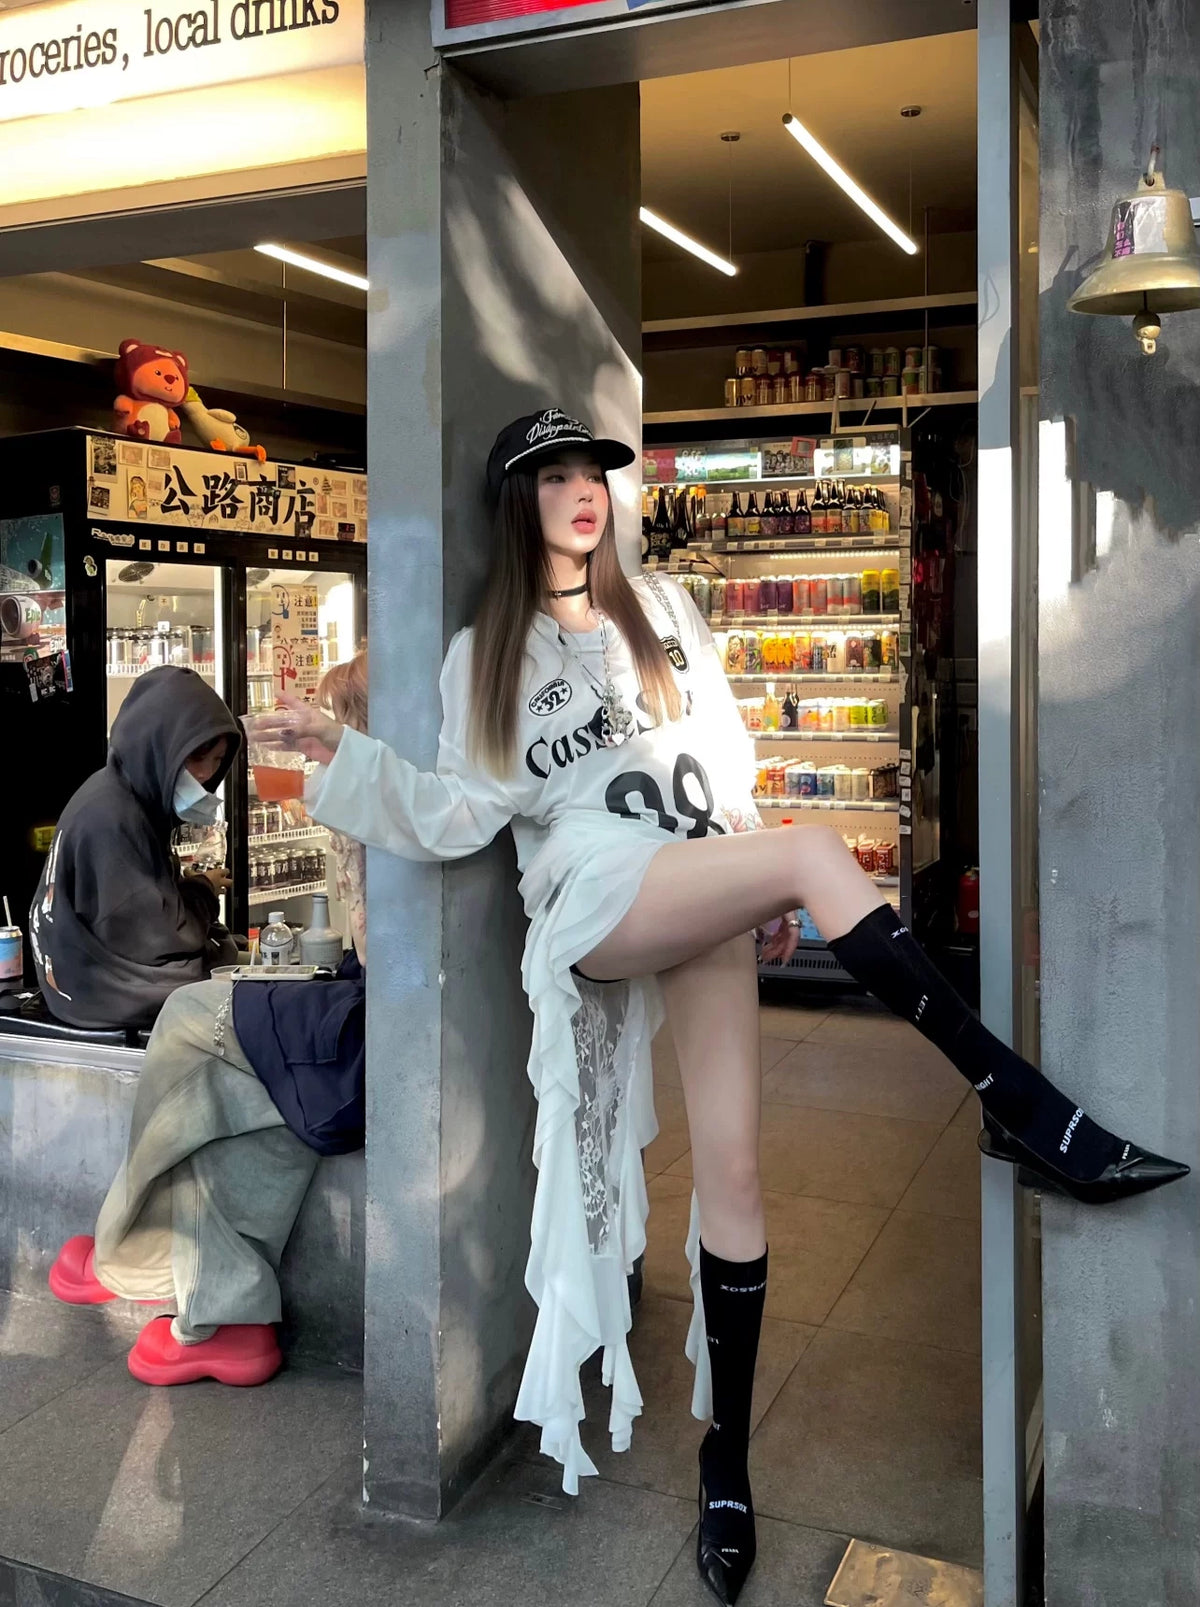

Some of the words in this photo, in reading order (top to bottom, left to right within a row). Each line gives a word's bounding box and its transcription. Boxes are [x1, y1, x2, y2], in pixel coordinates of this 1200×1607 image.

[143, 0, 221, 57] local
[230, 0, 340, 41] drinks
[161, 465, 316, 532] 公路商店
[668, 649, 685, 667] 10
[540, 690, 566, 712] 32
[1059, 1107, 1084, 1154] SUPRSO
[708, 1499, 748, 1514] SUPRSOX
